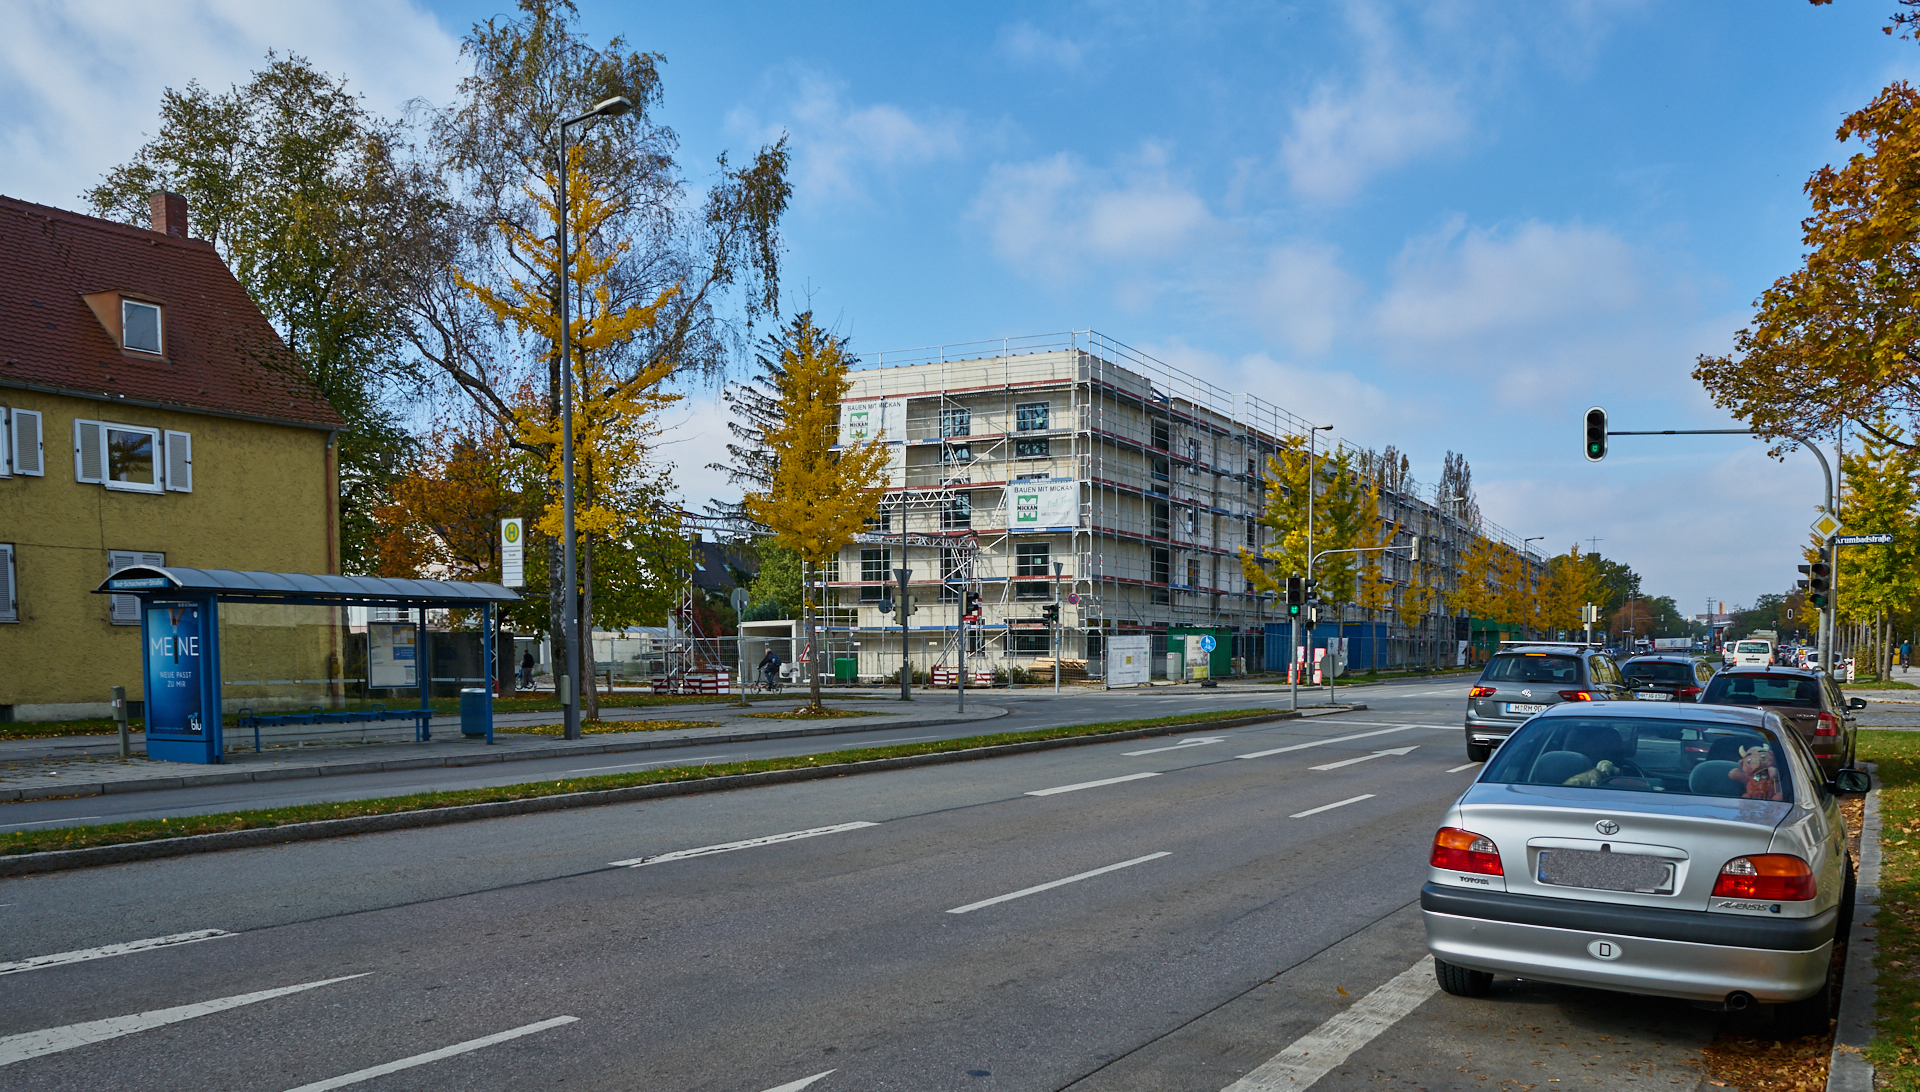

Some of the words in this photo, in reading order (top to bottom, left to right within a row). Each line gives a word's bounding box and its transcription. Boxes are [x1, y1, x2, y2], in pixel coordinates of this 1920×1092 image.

[508, 527, 516, 538] H
[1835, 534, 1891, 544] Krumbadstraße
[113, 579, 163, 588] Bad-Schachener-Straße
[160, 671, 175, 679] NEUE
[176, 671, 192, 679] PASST
[190, 718, 202, 731] blu
[1459, 875, 1490, 885] TOYOTA
[1716, 900, 1768, 911] AVENSIS
[1599, 942, 1611, 957] D
